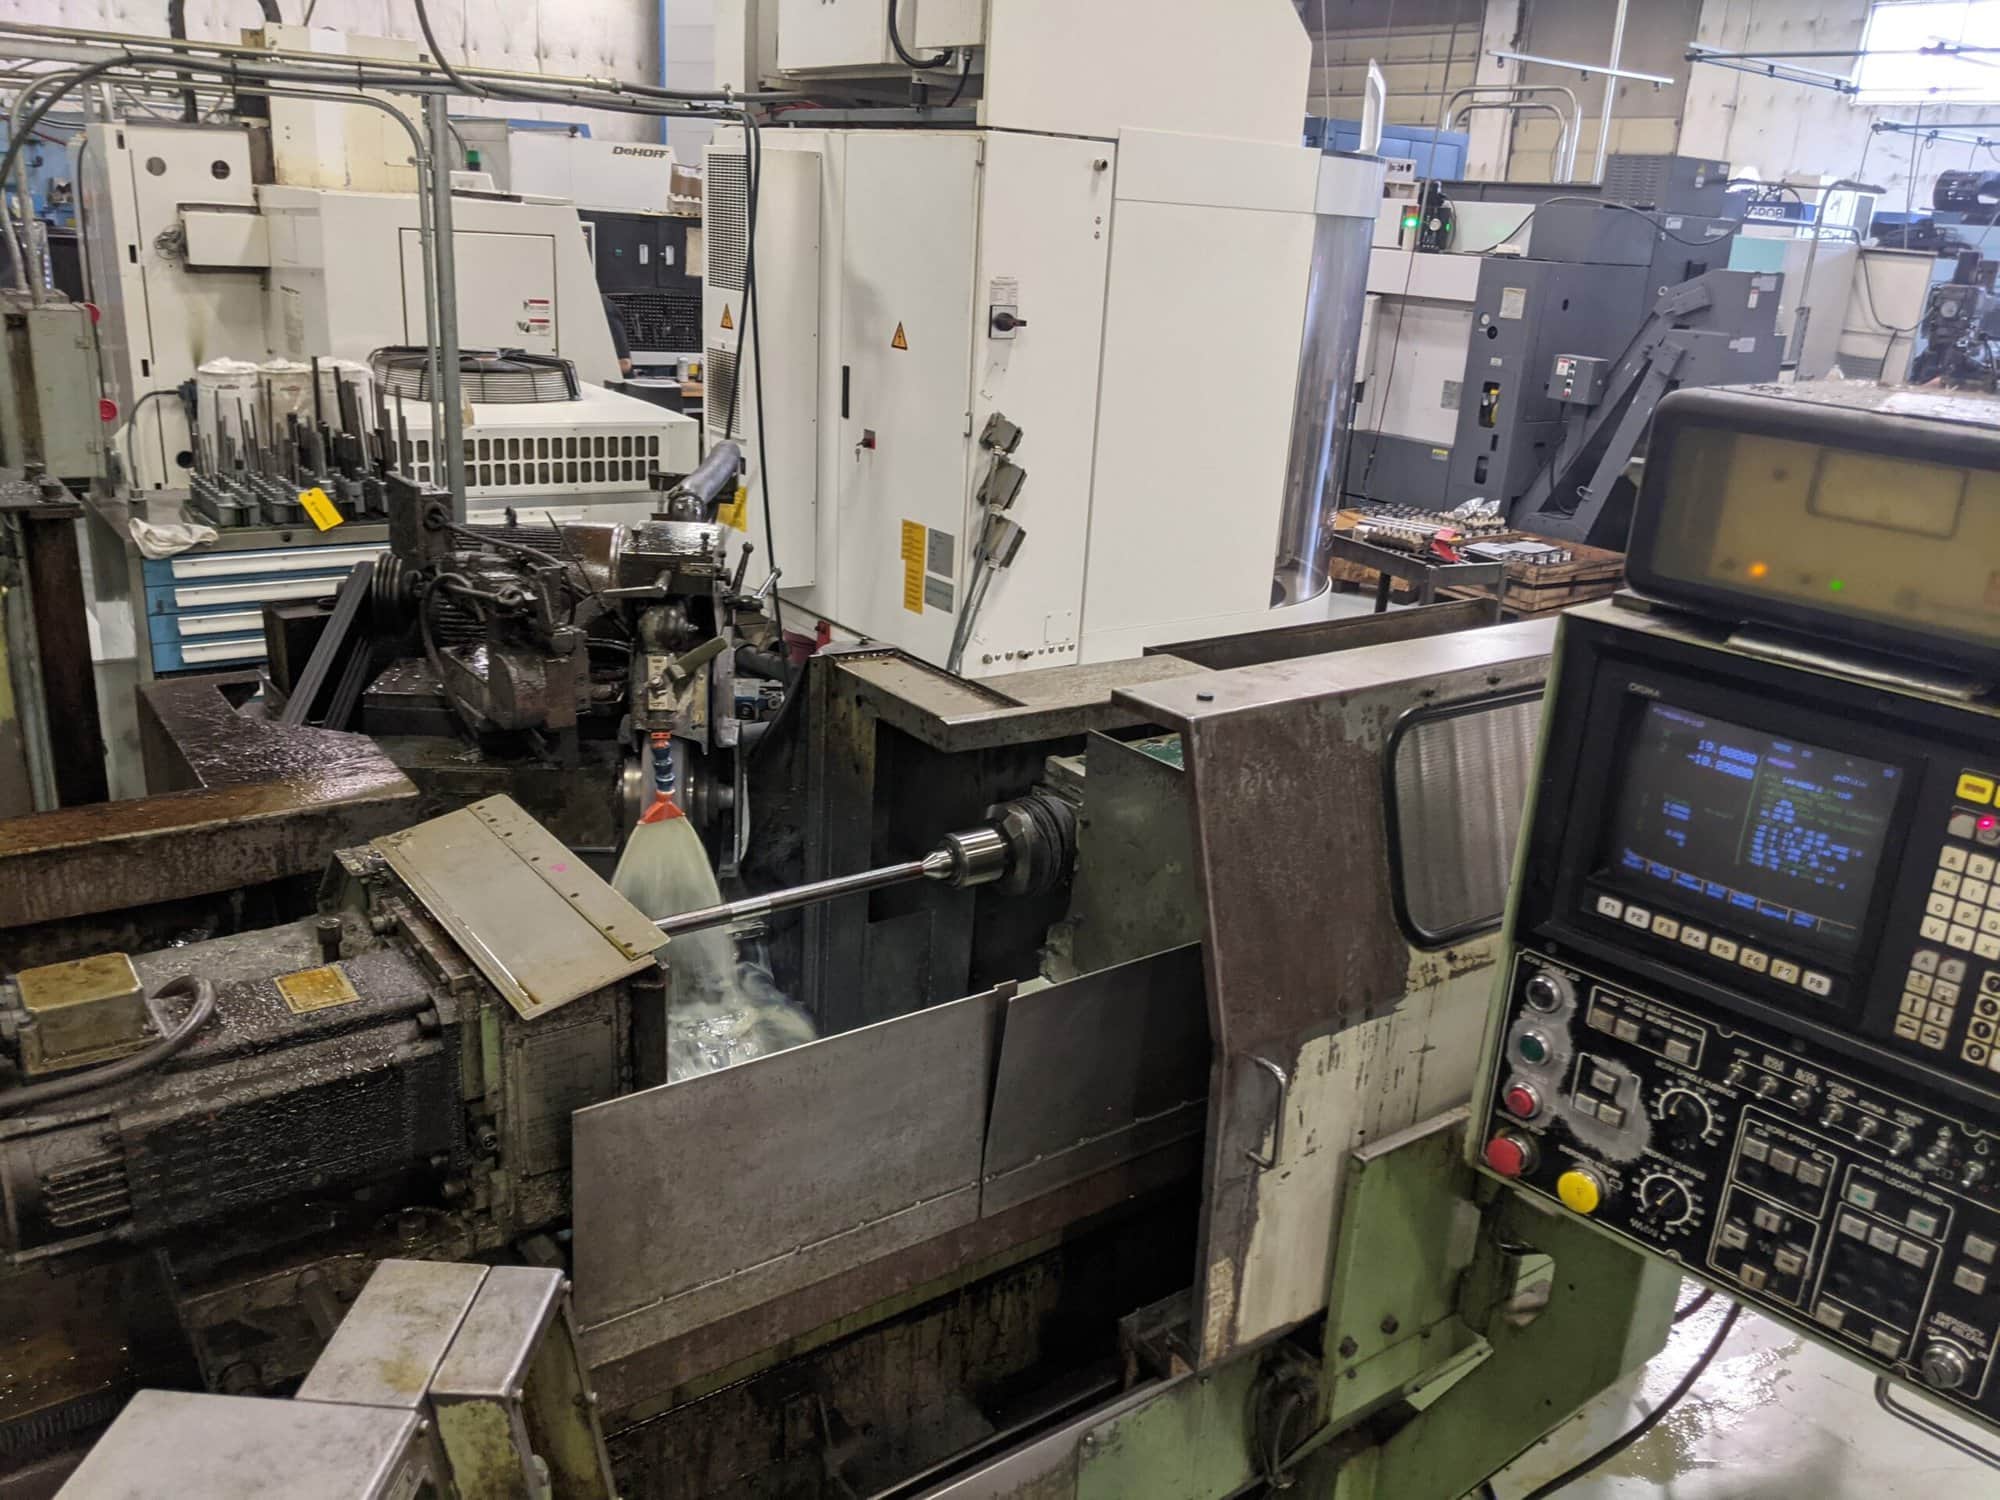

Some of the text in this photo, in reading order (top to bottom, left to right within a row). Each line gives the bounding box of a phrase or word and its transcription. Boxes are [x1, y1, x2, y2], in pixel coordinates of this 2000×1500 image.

[1604, 901, 1616, 912] F1
[1631, 912, 1643, 923] F2
[1658, 921, 1672, 933] F3
[1687, 932, 1700, 944] F4
[1716, 943, 1730, 955] F5
[1746, 954, 1760, 966] F6
[1776, 965, 1791, 977] F7
[1809, 977, 1823, 989] F8
